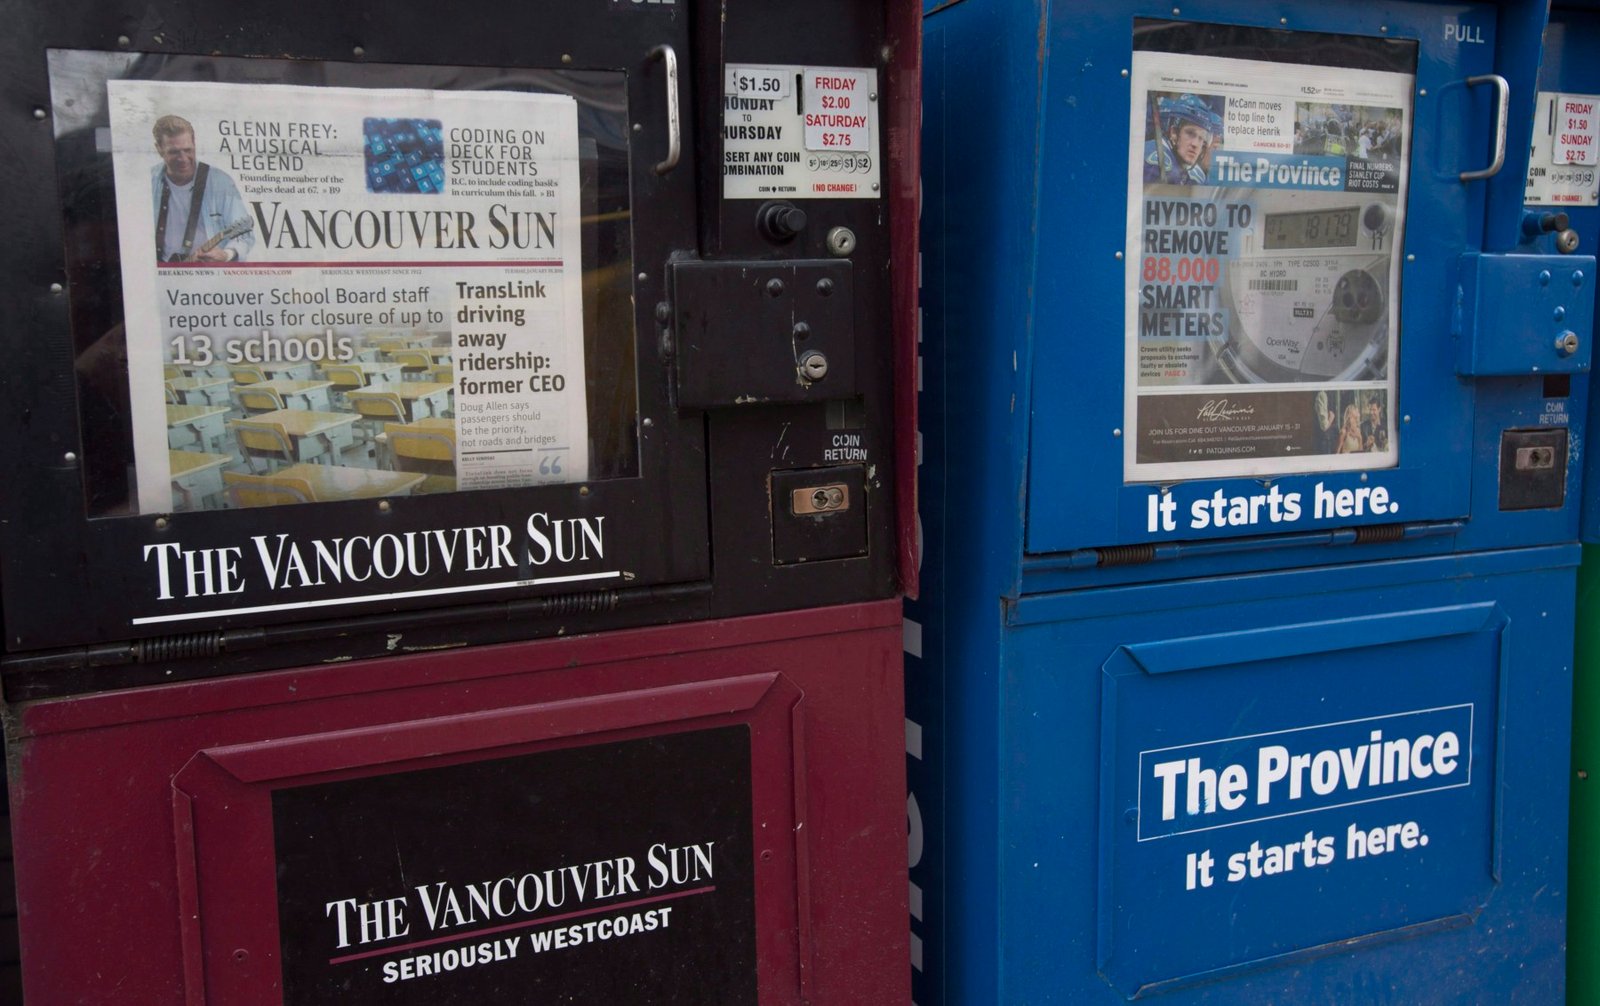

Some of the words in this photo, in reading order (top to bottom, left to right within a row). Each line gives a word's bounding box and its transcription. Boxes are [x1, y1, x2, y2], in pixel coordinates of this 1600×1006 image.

[1444, 24, 1485, 43] PULL
[740, 76, 780, 92] $1.50
[816, 77, 856, 90] FRIDAY
[822, 95, 850, 109] $2.00
[1229, 98, 1257, 108] McCann
[1259, 102, 1282, 110] moves
[1566, 103, 1593, 114] FRIDAY
[742, 114, 752, 122] TO
[806, 114, 866, 128] SATURDAY
[1228, 111, 1235, 120] to
[1238, 112, 1250, 123] top
[1252, 112, 1265, 123] line
[1267, 114, 1274, 123] to
[1568, 118, 1588, 130] $1.50
[219, 120, 280, 137] GLENN
[289, 123, 337, 139] FREY:
[450, 128, 516, 144] CODING
[522, 130, 545, 145] ON
[724, 126, 782, 140] HURSDAY
[1228, 125, 1255, 136] replace
[1257, 126, 1280, 136] Henrik
[823, 132, 851, 146] $2.75
[1561, 134, 1592, 145] SUNDAY
[220, 138, 231, 152] A
[238, 138, 322, 155] MUSICAL
[451, 144, 494, 160] DECK
[500, 146, 532, 160] FOR
[726, 152, 750, 162] SERT
[754, 152, 773, 162] ANY
[777, 152, 800, 162] COIN
[1566, 150, 1585, 161] $2.75
[231, 155, 304, 171] LEGEND
[451, 160, 538, 176] STUDENTS
[723, 165, 784, 175] OMBINATION
[1350, 162, 1365, 170] FINAL
[1367, 162, 1393, 172] NUMBERS:
[1216, 155, 1253, 182] The
[1256, 158, 1341, 186] Province
[1349, 170, 1372, 179] STANLEY
[1374, 171, 1385, 180] CUP
[1530, 168, 1546, 176] COIN
[240, 174, 281, 184] Founding
[282, 175, 318, 183] member
[320, 175, 330, 183] of
[451, 178, 466, 186] B.C.
[507, 179, 533, 188] coding
[1362, 180, 1379, 188] COSTS
[245, 185, 272, 194] Eagles
[506, 189, 521, 197] this
[1145, 201, 1217, 227] HYDRO
[1226, 204, 1251, 228] TO
[250, 202, 479, 249] VANCOUVER
[489, 203, 557, 249] SUN
[1145, 229, 1228, 255] REMOVE
[1143, 257, 1219, 285] 88,000
[1270, 270, 1286, 278] HYDRO
[167, 289, 264, 306] Vancouver
[271, 287, 330, 305] School
[336, 287, 386, 304] Board
[393, 287, 430, 303] staff
[456, 280, 546, 299] TransLink
[1143, 285, 1214, 309] SMART
[169, 312, 226, 331] report
[234, 310, 274, 327] calls
[281, 309, 304, 326] for
[311, 309, 372, 325] closure
[379, 308, 396, 324] of
[401, 310, 421, 327] up
[428, 309, 443, 323] to
[457, 305, 526, 326] driving
[1142, 312, 1224, 337] METERS
[170, 335, 213, 367] 13
[226, 330, 354, 363] schools
[458, 333, 506, 350] away
[460, 351, 550, 373] ridership:
[460, 377, 523, 395] former
[530, 375, 565, 392] CEO
[460, 402, 483, 413] Doug
[486, 402, 508, 410] Allen
[511, 402, 529, 411] says
[1546, 402, 1564, 412] COIN
[461, 414, 510, 424] passengers
[513, 412, 541, 421] should
[1539, 414, 1568, 424] RETURN
[462, 427, 472, 436] be
[475, 427, 488, 435] the
[492, 425, 526, 436] priority,
[462, 439, 476, 447] not
[479, 437, 503, 446] roads
[506, 436, 522, 445] and
[524, 435, 556, 445] bridges
[832, 434, 860, 447] COIN
[824, 449, 867, 461] RETURN
[1147, 491, 1176, 532] It
[1190, 484, 1301, 529] starts
[1314, 481, 1399, 519] here.
[144, 542, 244, 600] THE
[251, 524, 517, 590] VANCOUVER
[528, 512, 605, 566] SUN
[1154, 757, 1248, 821] The
[1256, 730, 1459, 805] Province
[1186, 849, 1214, 890] It
[1227, 831, 1335, 882] starts
[1347, 821, 1429, 860] here.
[327, 897, 409, 948] THE
[415, 856, 640, 931] VANCOUVER
[648, 842, 714, 890] SUN
[383, 937, 520, 984] SERIOUSLY
[531, 908, 672, 953] WESTCOAST
